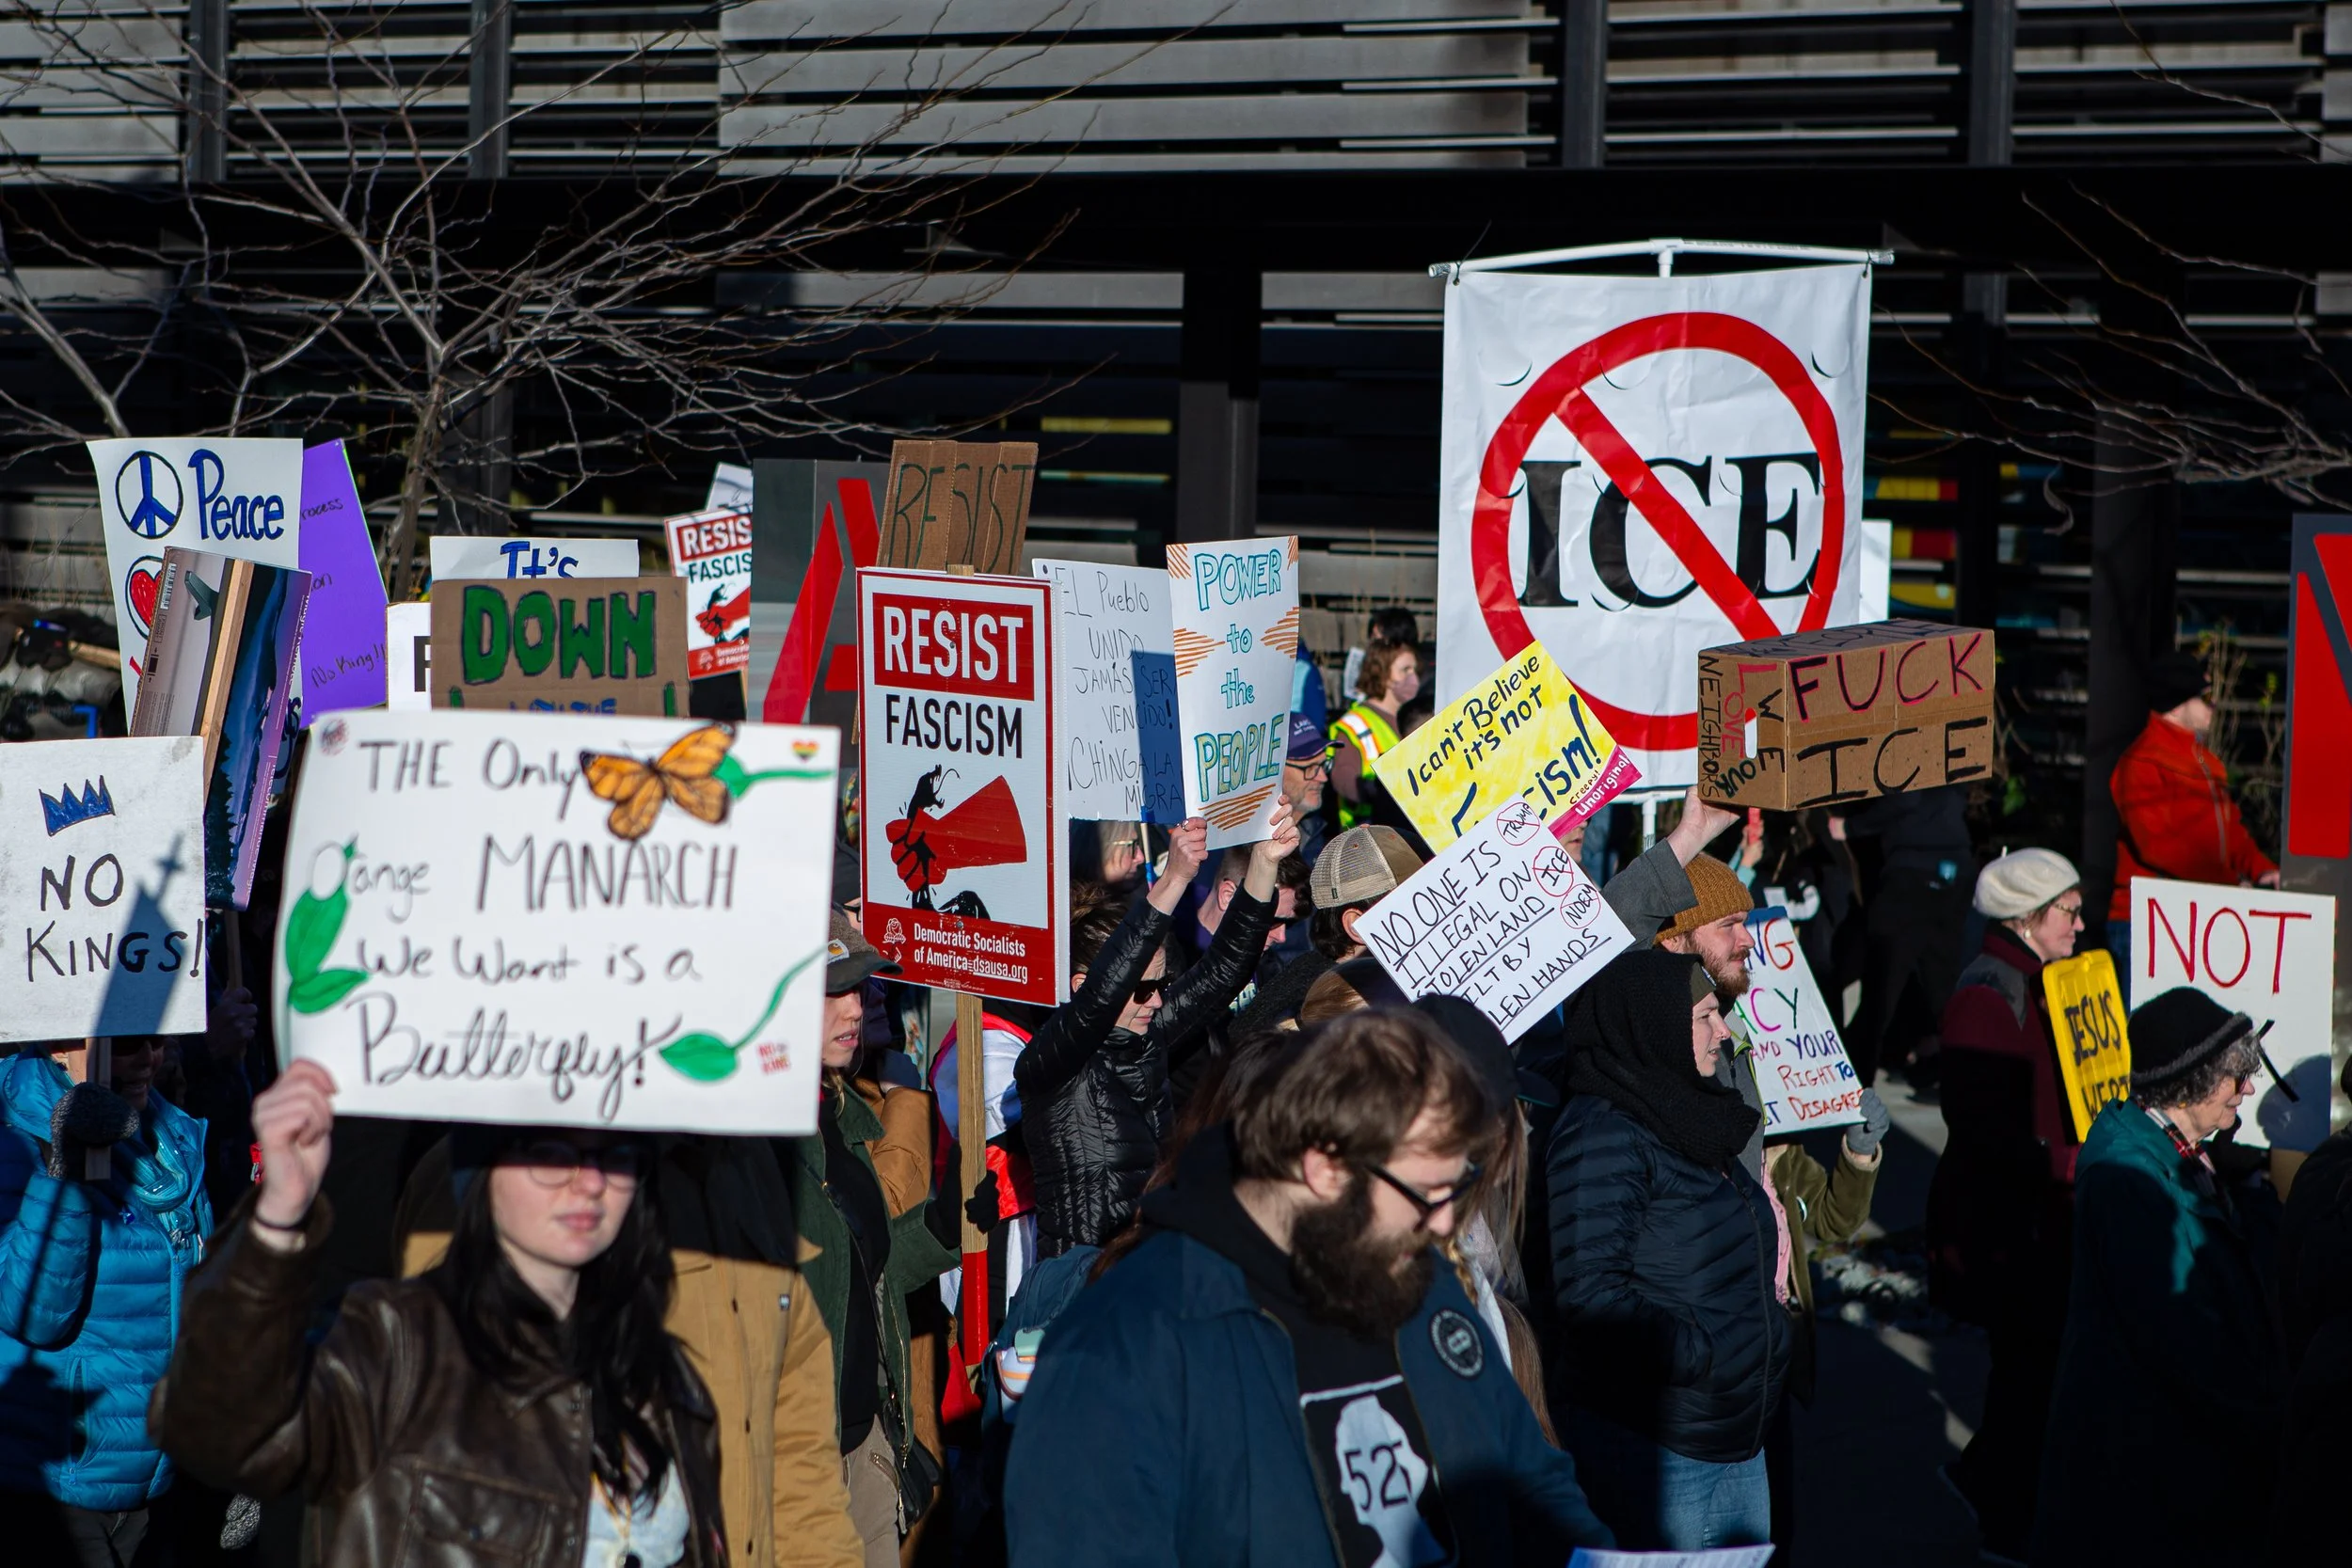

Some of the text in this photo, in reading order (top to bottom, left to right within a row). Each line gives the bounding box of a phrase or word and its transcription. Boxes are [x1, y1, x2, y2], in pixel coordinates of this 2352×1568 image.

[188, 449, 285, 540] Peace
[301, 499, 343, 520] rocess
[888, 463, 1035, 574] RESIST
[681, 517, 753, 557] RESIS
[1516, 451, 1824, 610] ICE
[689, 553, 753, 584] FASCIS
[1097, 570, 1150, 613] Pueblo
[1194, 548, 1282, 611] POWER
[461, 584, 657, 686] DOWN
[883, 606, 1024, 684] RESIST
[1089, 627, 1144, 661] UNIDO
[1226, 624, 1252, 654] to
[1140, 664, 1176, 698] SER
[1220, 668, 1255, 709] the
[1788, 632, 1983, 723] FUCK
[885, 693, 1023, 758] FASCISM
[1406, 656, 1541, 797] I can't Believe
[1463, 684, 1543, 770] it's not
[358, 737, 580, 820] THE Only
[1154, 752, 1175, 777] LA
[1194, 713, 1284, 802] PEOPLE
[1574, 753, 1630, 816] Unoriginal
[1796, 716, 1988, 809] ICE
[1503, 802, 1531, 839] TRUMP
[40, 853, 124, 911] NO
[1541, 848, 1569, 886] ICE
[1370, 840, 1501, 964] NO ONE IS
[1395, 861, 1533, 990] ILLEGAL ON
[1486, 895, 1546, 947] LAND
[1565, 884, 1597, 926] NOEM
[26, 918, 204, 982] KINGS!
[357, 937, 702, 985] We Want is a
[914, 923, 1025, 958] Democratic Socialists
[914, 946, 1028, 984] of America dsausa.org
[1461, 937, 1532, 1006] ILT BY
[2147, 897, 2312, 996] NOT
[1488, 928, 1598, 1025] LEN HANDS
[345, 990, 681, 1124] Butterfly!
[1786, 1030, 1843, 1060] YOUR
[2064, 990, 2122, 1067] JESUS
[1777, 1060, 1854, 1090] RIGHT TO
